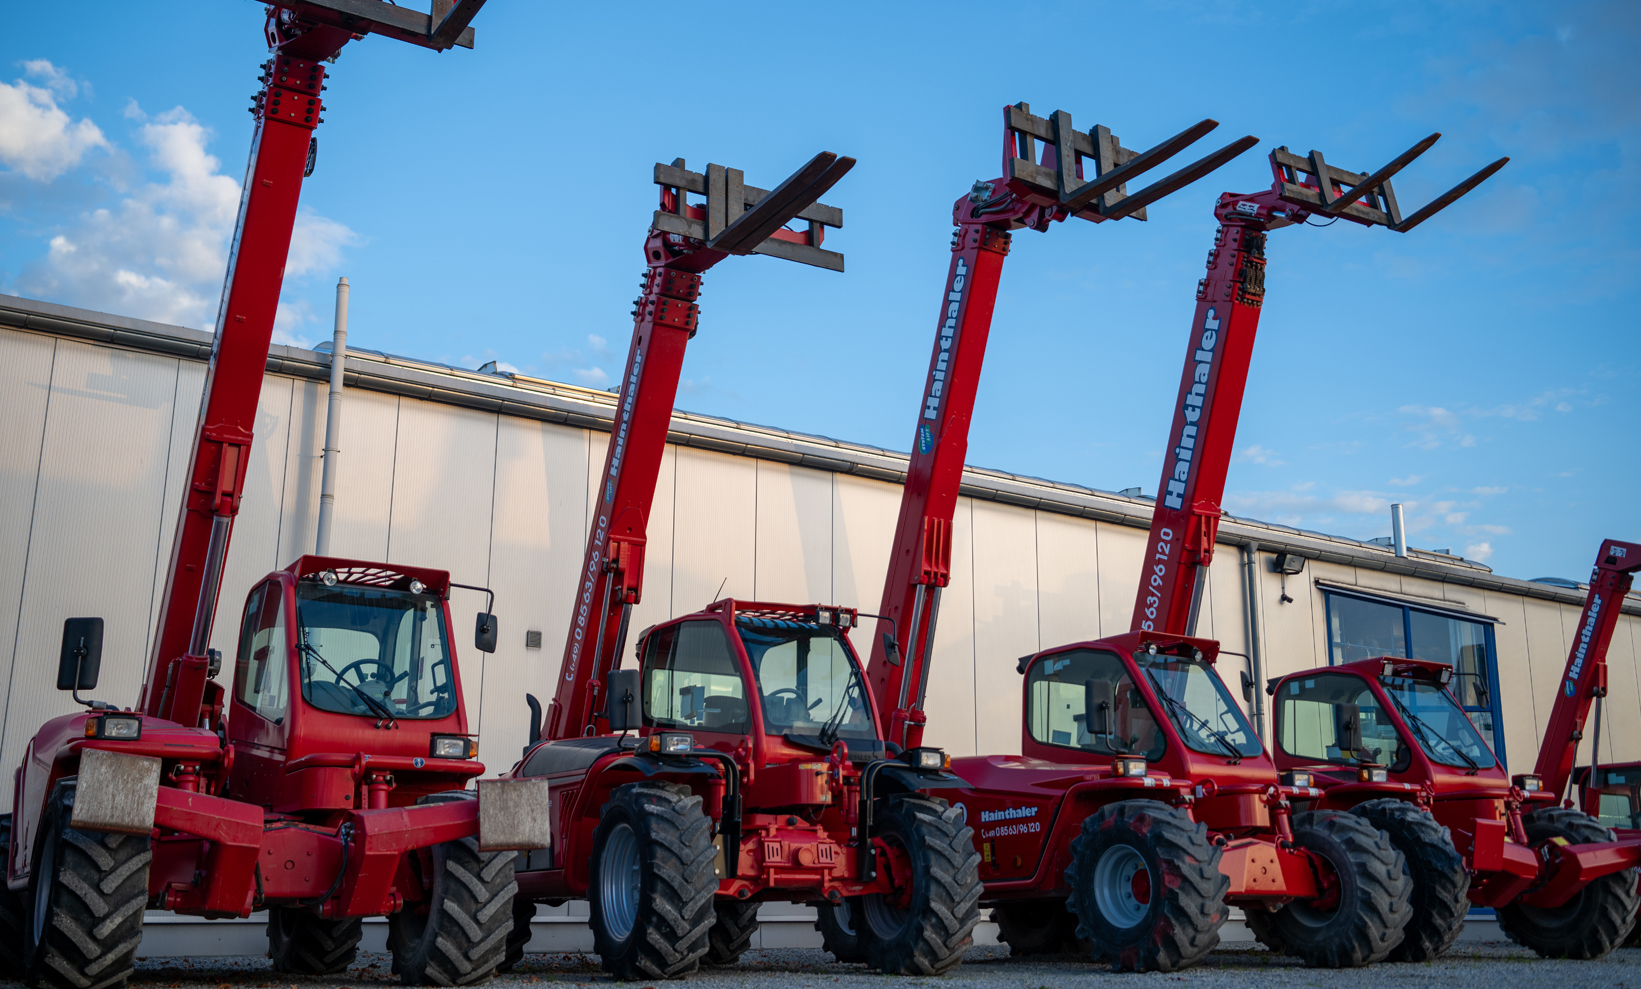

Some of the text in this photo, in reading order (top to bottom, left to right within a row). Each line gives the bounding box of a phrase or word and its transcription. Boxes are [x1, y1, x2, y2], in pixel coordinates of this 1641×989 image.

[924, 257, 968, 420] Hainthaler
[609, 348, 642, 477] Hainthaler
[1164, 307, 1221, 510] Hainthaler
[1568, 593, 1602, 679] Hainthaler
[981, 806, 1038, 822] Hainthaler
